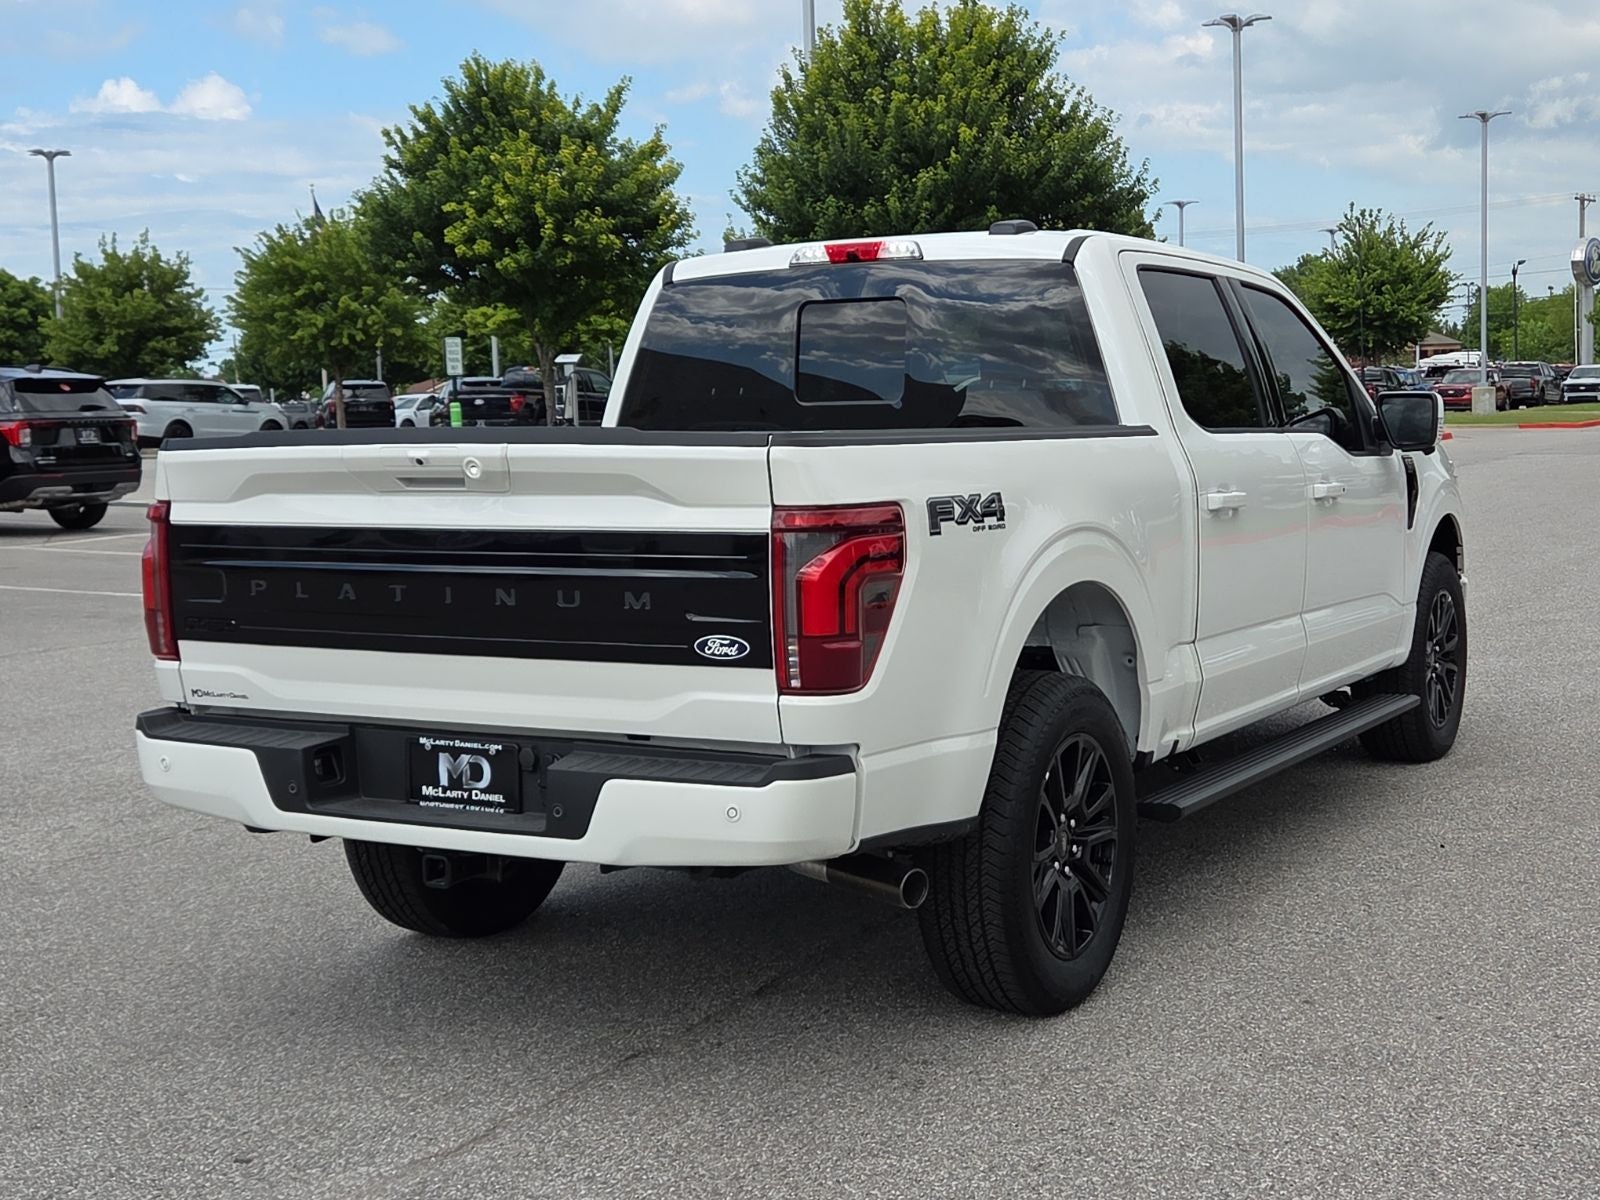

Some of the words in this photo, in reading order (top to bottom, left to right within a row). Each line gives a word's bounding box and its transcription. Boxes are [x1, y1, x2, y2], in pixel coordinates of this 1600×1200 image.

[926, 492, 1005, 536] FX4
[250, 579, 652, 611] PLATINUM
[704, 639, 739, 656] Ford
[471, 790, 506, 803] DANIEL
